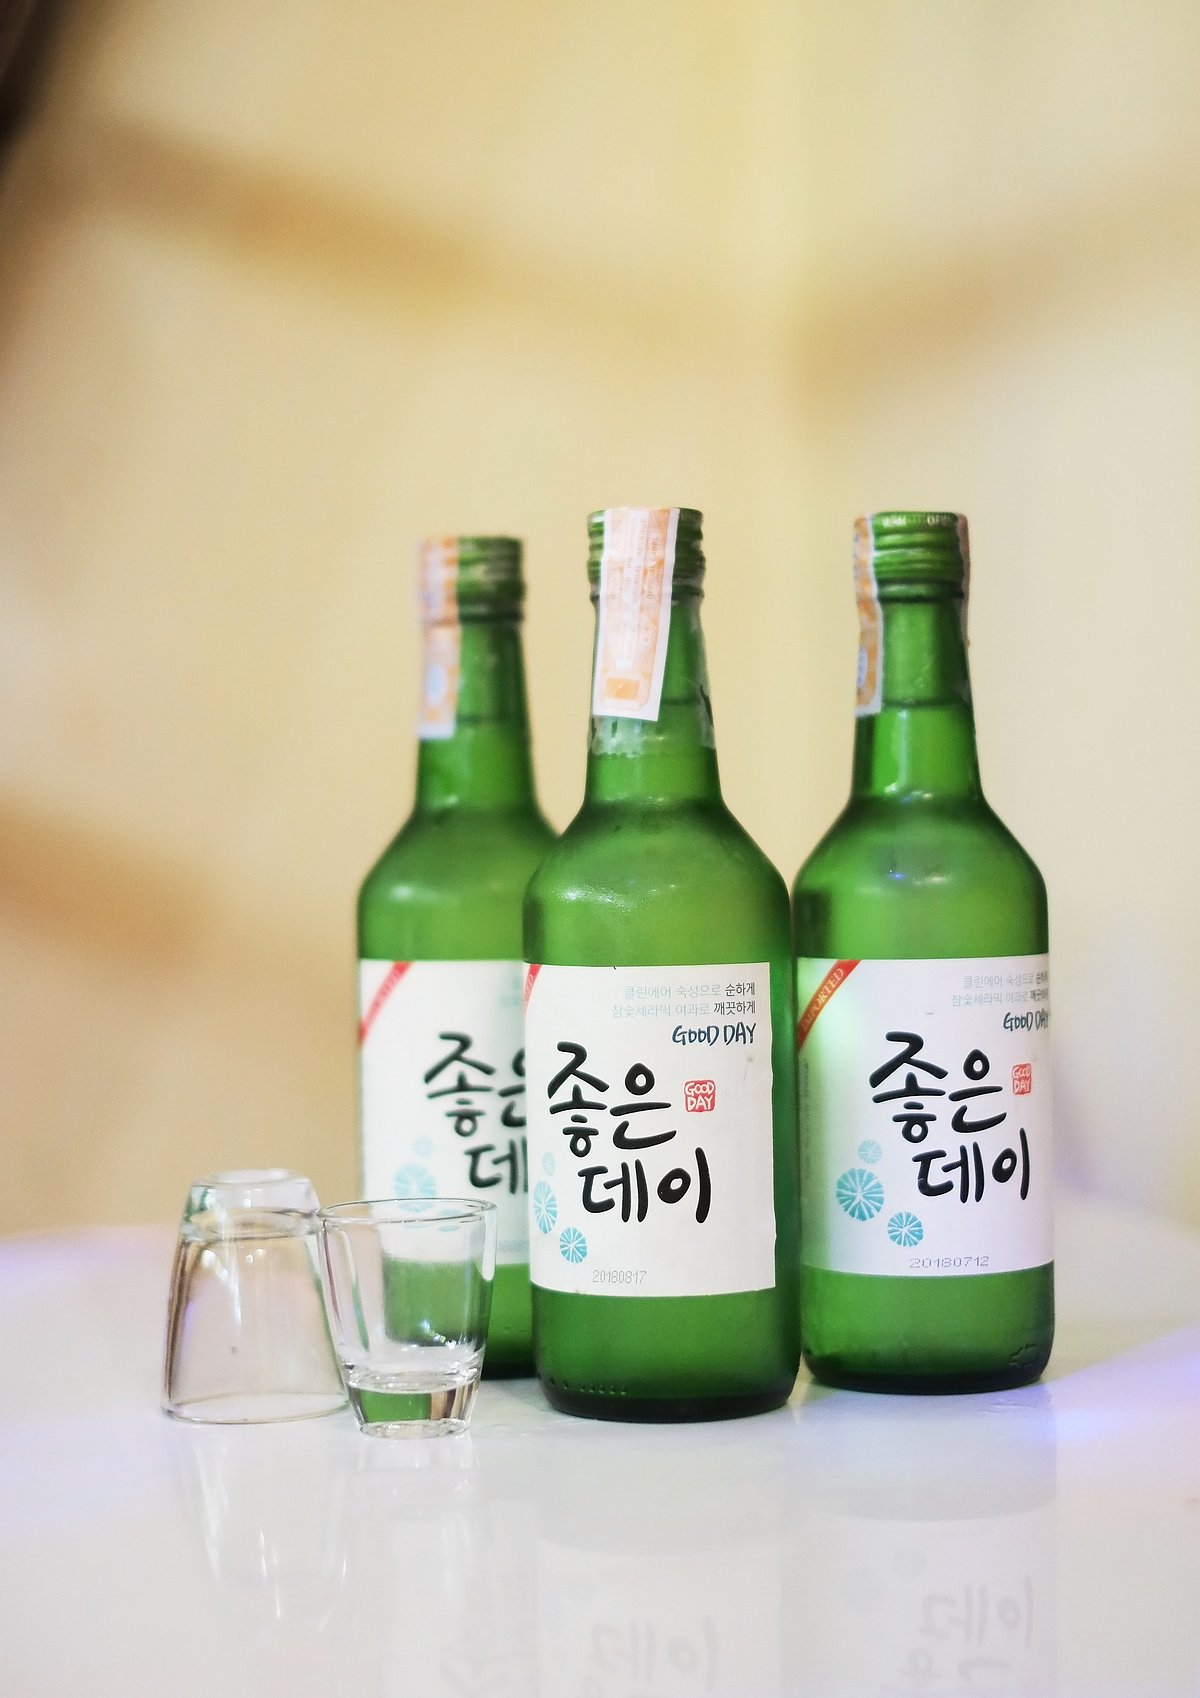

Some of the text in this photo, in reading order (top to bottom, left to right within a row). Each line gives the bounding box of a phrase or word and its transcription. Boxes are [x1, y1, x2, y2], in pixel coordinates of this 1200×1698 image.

[625, 981, 755, 1000] 클린에어 숙성으로 순하게
[675, 1003, 710, 1016] 여과로
[714, 1000, 756, 1016] 깨끗하게
[1003, 1011, 1033, 1031] GOOD
[672, 1021, 756, 1046] GOOD DAY
[685, 1081, 715, 1097] GOOD
[869, 1031, 1007, 1144] 좋은
[1014, 1078, 1031, 1094] DAY
[548, 1042, 677, 1158] 좋은
[686, 1095, 713, 1111] DAY
[911, 1127, 1031, 1204] 데이
[577, 1147, 712, 1224] 데이
[909, 1255, 989, 1269] 20180712
[592, 1269, 647, 1284] 20180817
